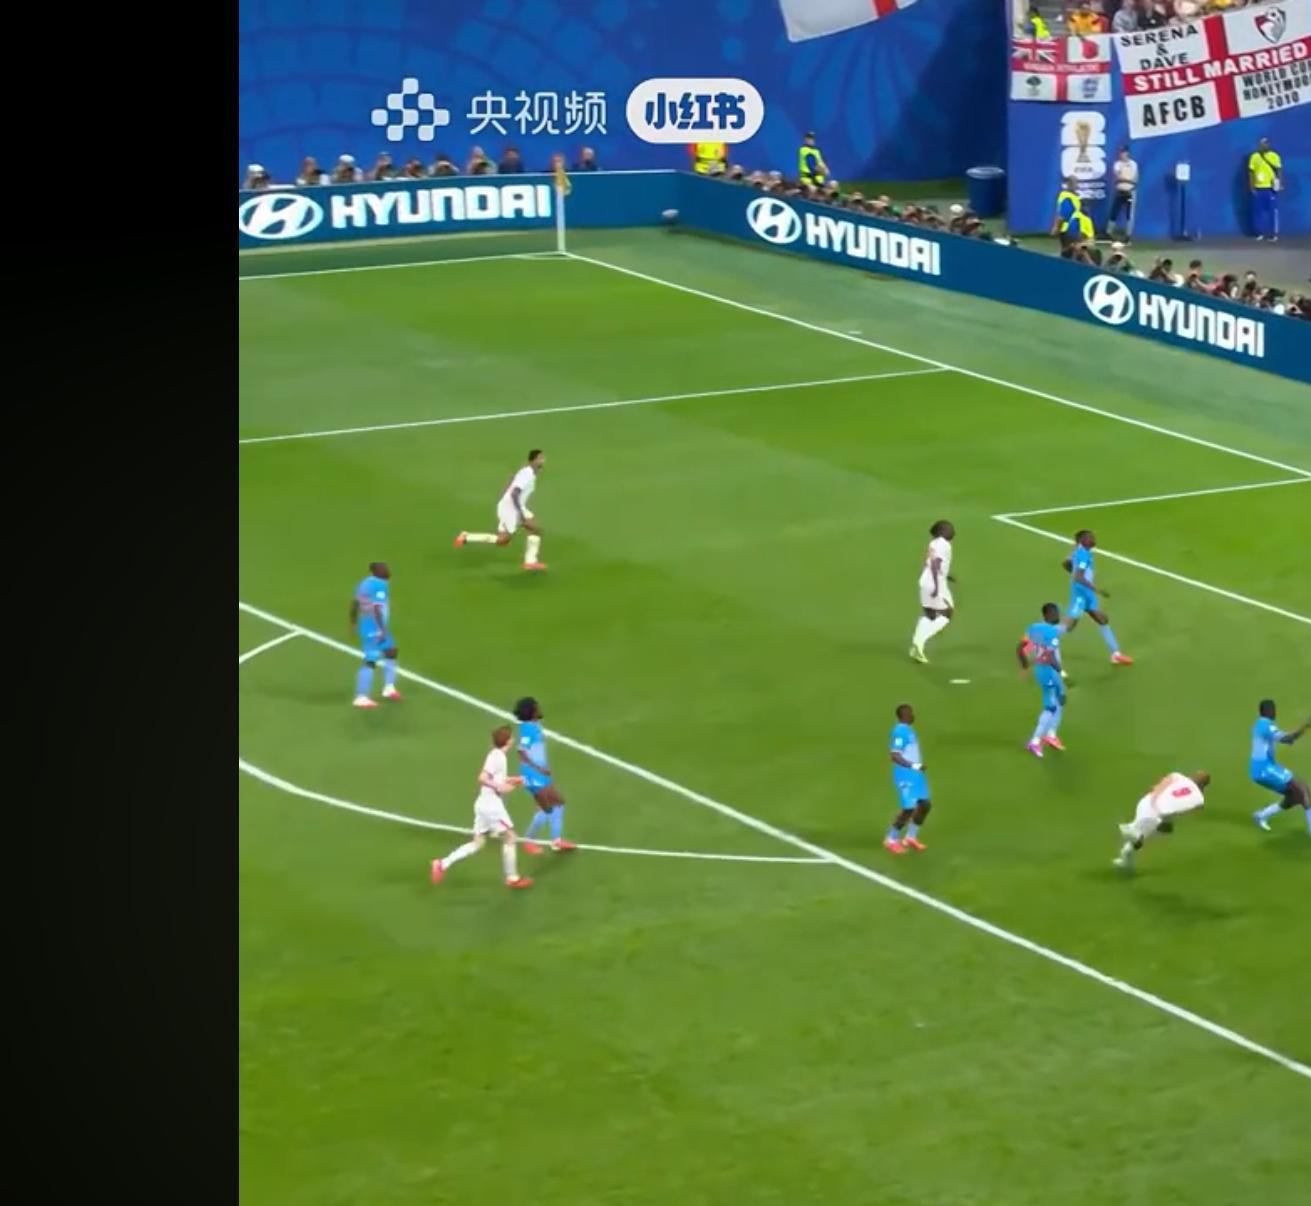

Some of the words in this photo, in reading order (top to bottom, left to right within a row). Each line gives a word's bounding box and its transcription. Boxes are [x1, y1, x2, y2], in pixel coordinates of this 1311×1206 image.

[1120, 24, 1199, 47] SERENA
[1133, 68, 1201, 92] STILL
[1202, 41, 1308, 79] MARRIED
[1140, 52, 1188, 71] DAVE
[1242, 67, 1287, 87] WORLD
[1142, 95, 1205, 127] AFCB
[1267, 91, 1299, 110] 2010
[331, 184, 551, 228] HYUNDAI
[805, 212, 941, 275] HYUNDAI
[1138, 290, 1265, 358] HYUNDAI
